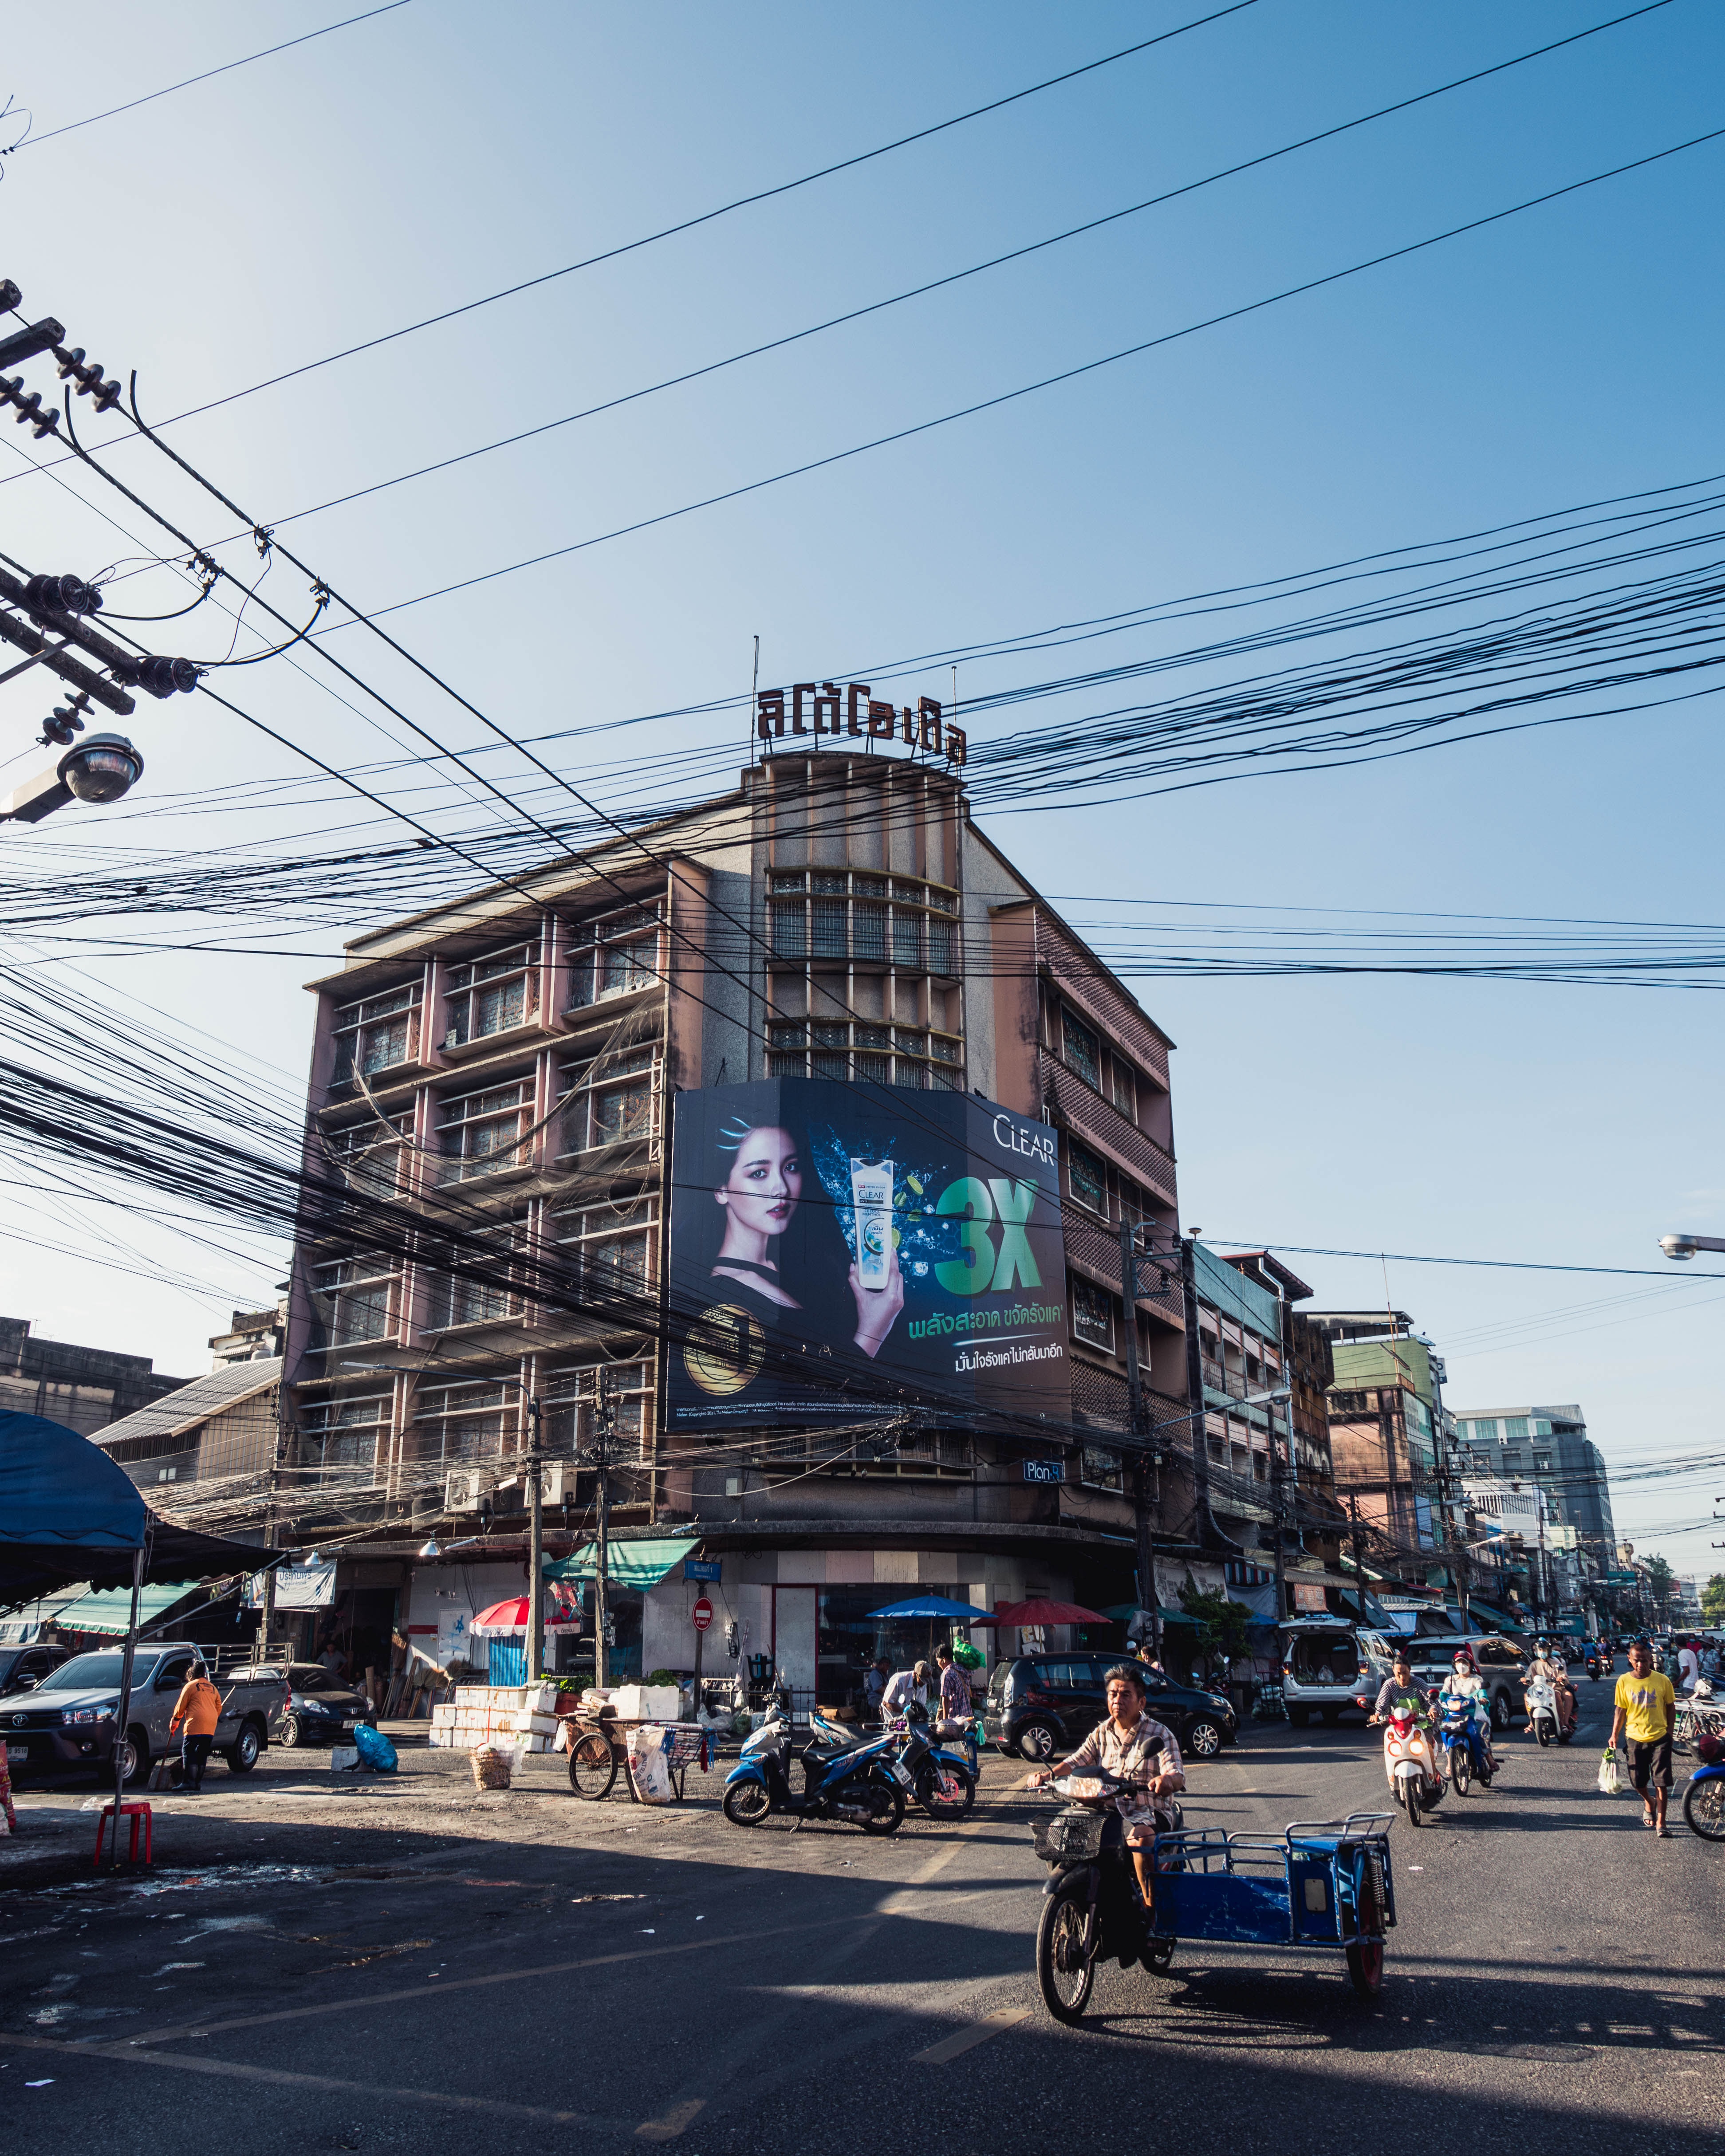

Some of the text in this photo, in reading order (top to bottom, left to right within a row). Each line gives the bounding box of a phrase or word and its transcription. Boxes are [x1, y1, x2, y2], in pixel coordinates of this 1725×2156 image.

[993, 1114, 1055, 1166] CLEAR
[859, 1189, 883, 1199] CLEAR
[934, 1176, 1044, 1298] 3X
[909, 1310, 1000, 1339] พลังสะอาด
[1028, 1463, 1050, 1480] Plan
